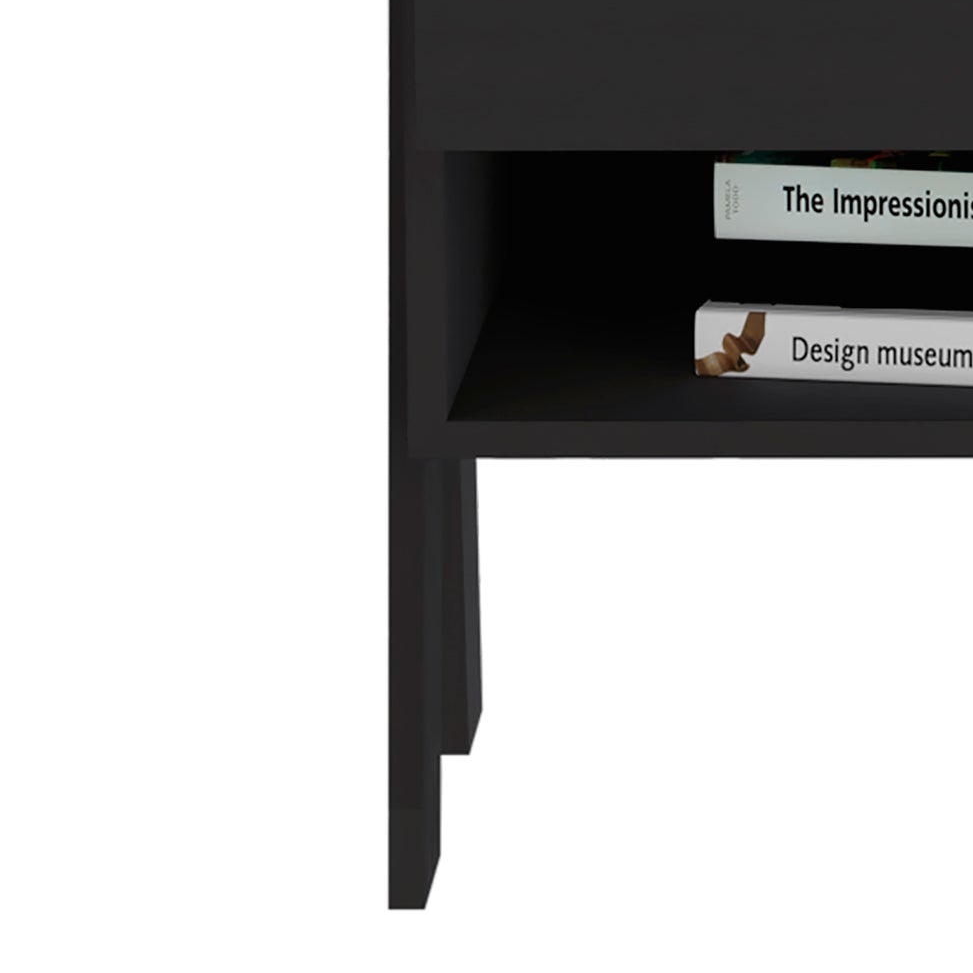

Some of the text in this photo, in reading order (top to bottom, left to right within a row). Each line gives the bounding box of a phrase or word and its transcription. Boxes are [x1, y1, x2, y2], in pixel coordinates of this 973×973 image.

[732, 185, 740, 214] TODD
[782, 184, 824, 214] The
[792, 336, 869, 372] Design
[877, 345, 973, 369] museum
